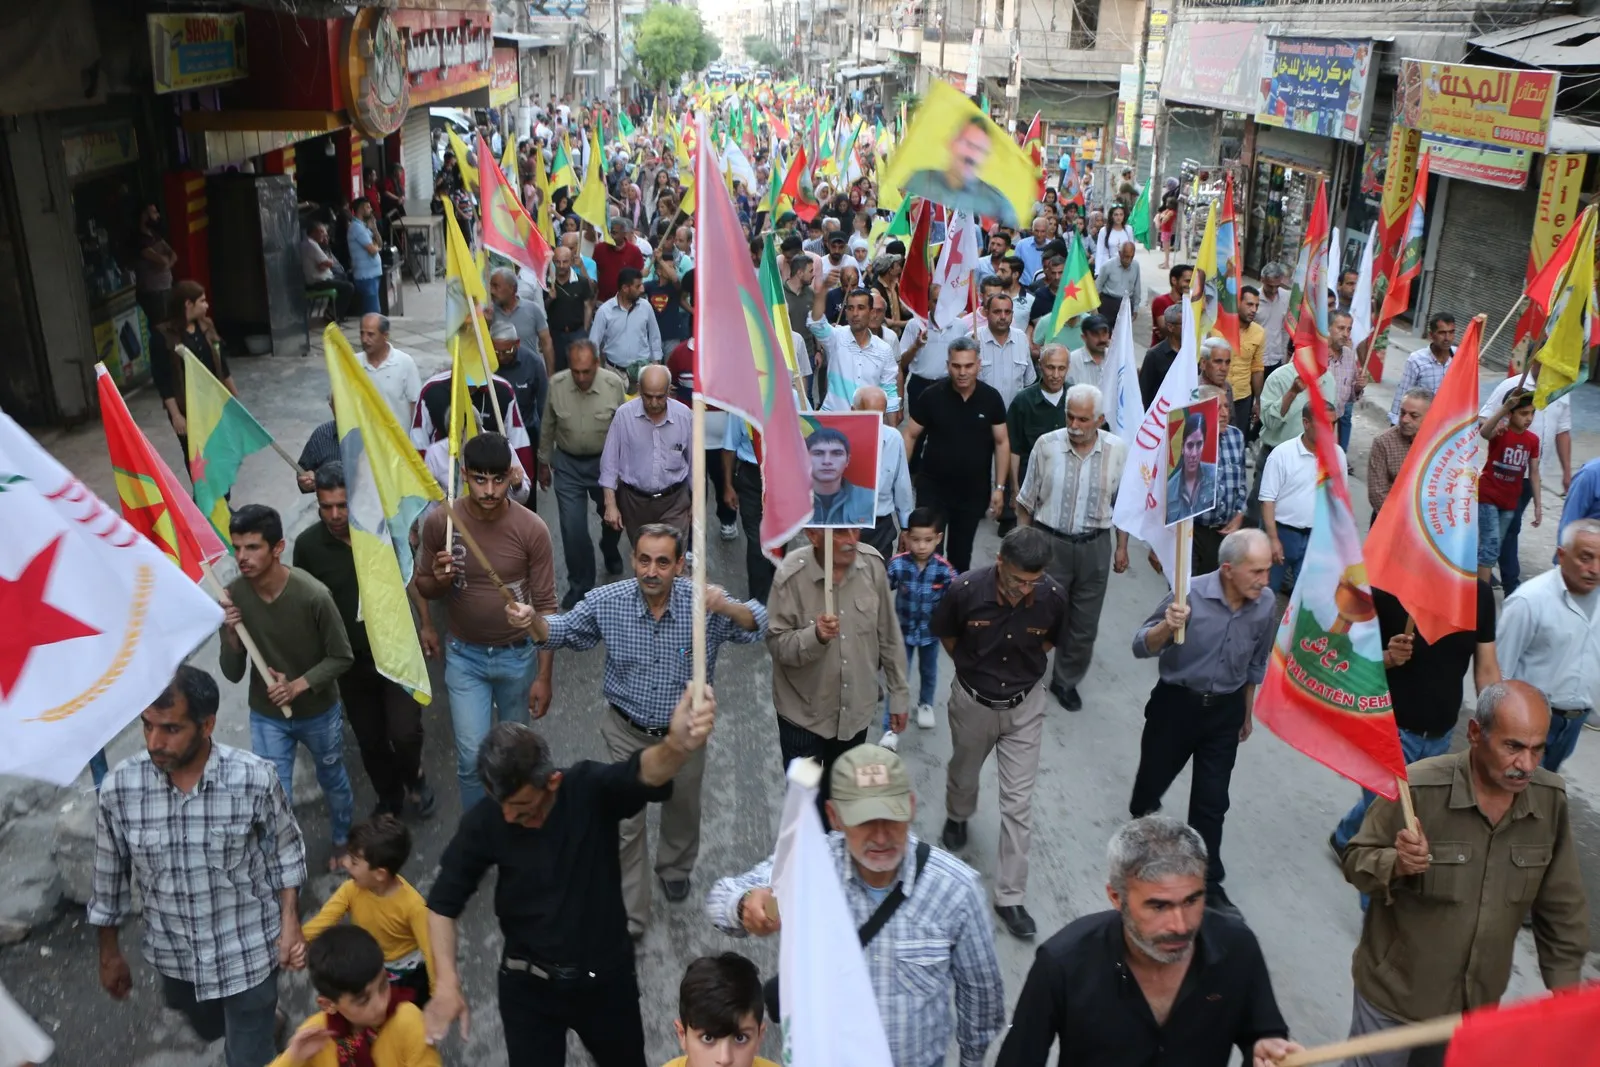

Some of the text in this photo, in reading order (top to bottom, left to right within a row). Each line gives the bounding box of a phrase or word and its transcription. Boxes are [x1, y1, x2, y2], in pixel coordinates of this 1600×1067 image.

[185, 17, 219, 43] SHOW
[1272, 55, 1353, 86] مركز رضوان للدخان
[1439, 66, 1548, 108] فطائر المحبة
[1551, 157, 1581, 248] Pies
